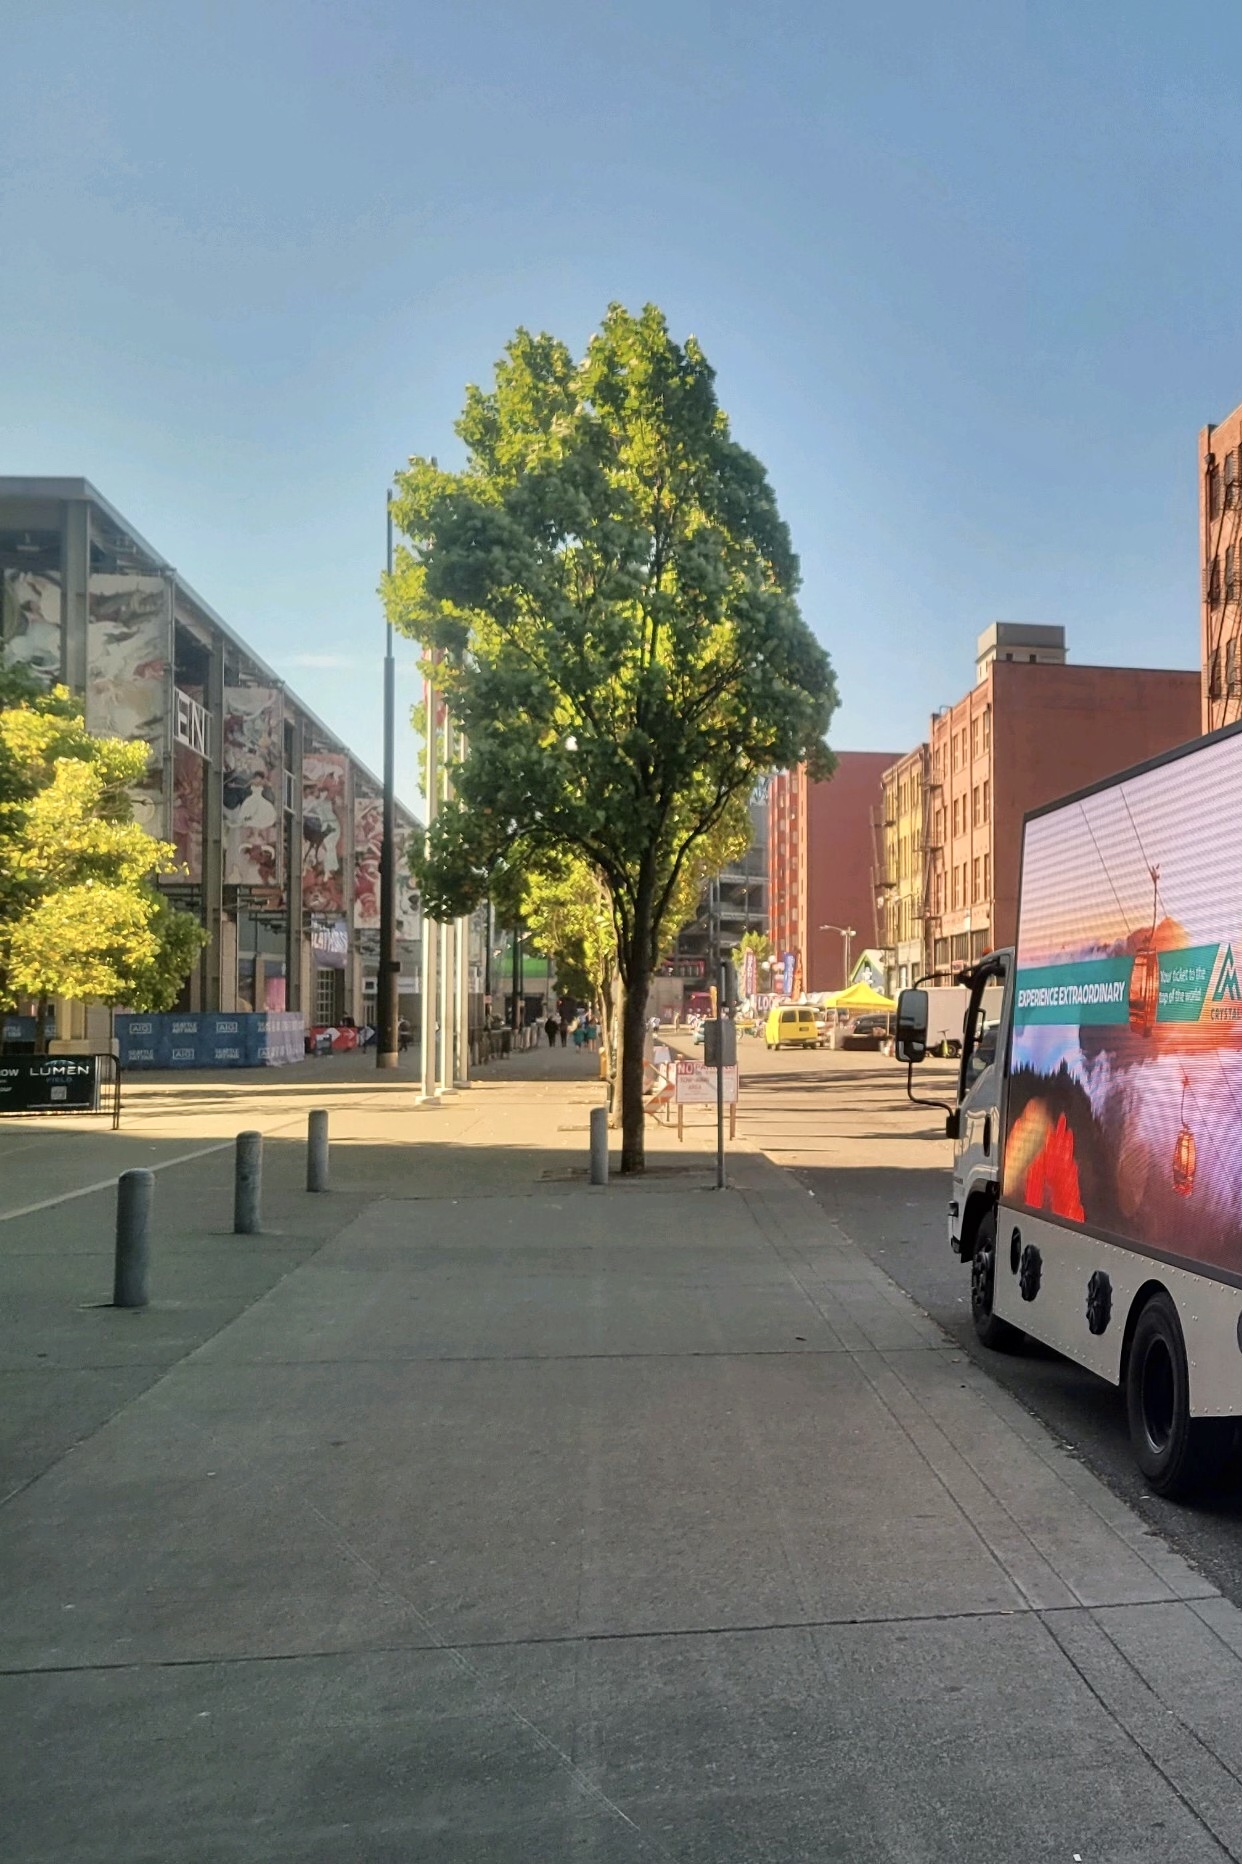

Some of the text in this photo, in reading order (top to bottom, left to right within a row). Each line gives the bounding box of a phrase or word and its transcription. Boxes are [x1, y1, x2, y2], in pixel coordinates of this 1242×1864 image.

[1018, 981, 1126, 1008] EXPERIENCE EXTRAORDINARY
[1210, 1007, 1241, 1021] CRYSTAL
[29, 1066, 90, 1076] LUMEN
[677, 1062, 694, 1074] NO
